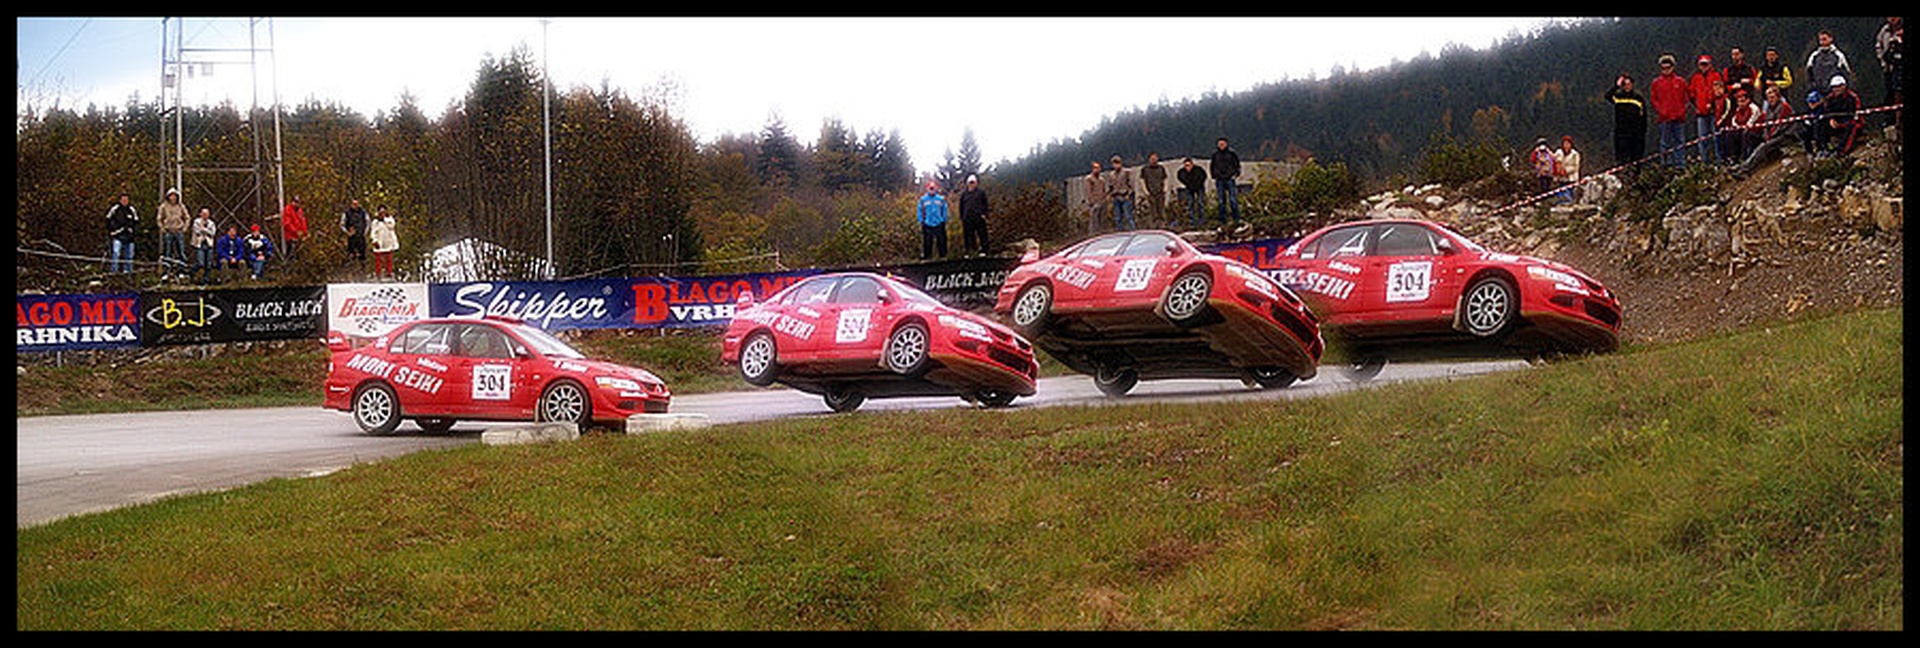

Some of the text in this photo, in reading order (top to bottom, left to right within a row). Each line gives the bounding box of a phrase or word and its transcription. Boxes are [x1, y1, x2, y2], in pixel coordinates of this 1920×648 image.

[925, 271, 974, 290] BLACK
[1305, 272, 1355, 299] SEIKI
[1393, 272, 1424, 292] 304
[79, 298, 137, 325] MIX
[235, 299, 325, 318] BLACK JACK
[448, 283, 607, 329] Skipper
[16, 325, 138, 346] RHNIKA
[776, 314, 817, 340] SEIKI
[346, 353, 396, 379] MORI
[394, 365, 444, 395] SEIKI
[477, 374, 505, 391] 304
